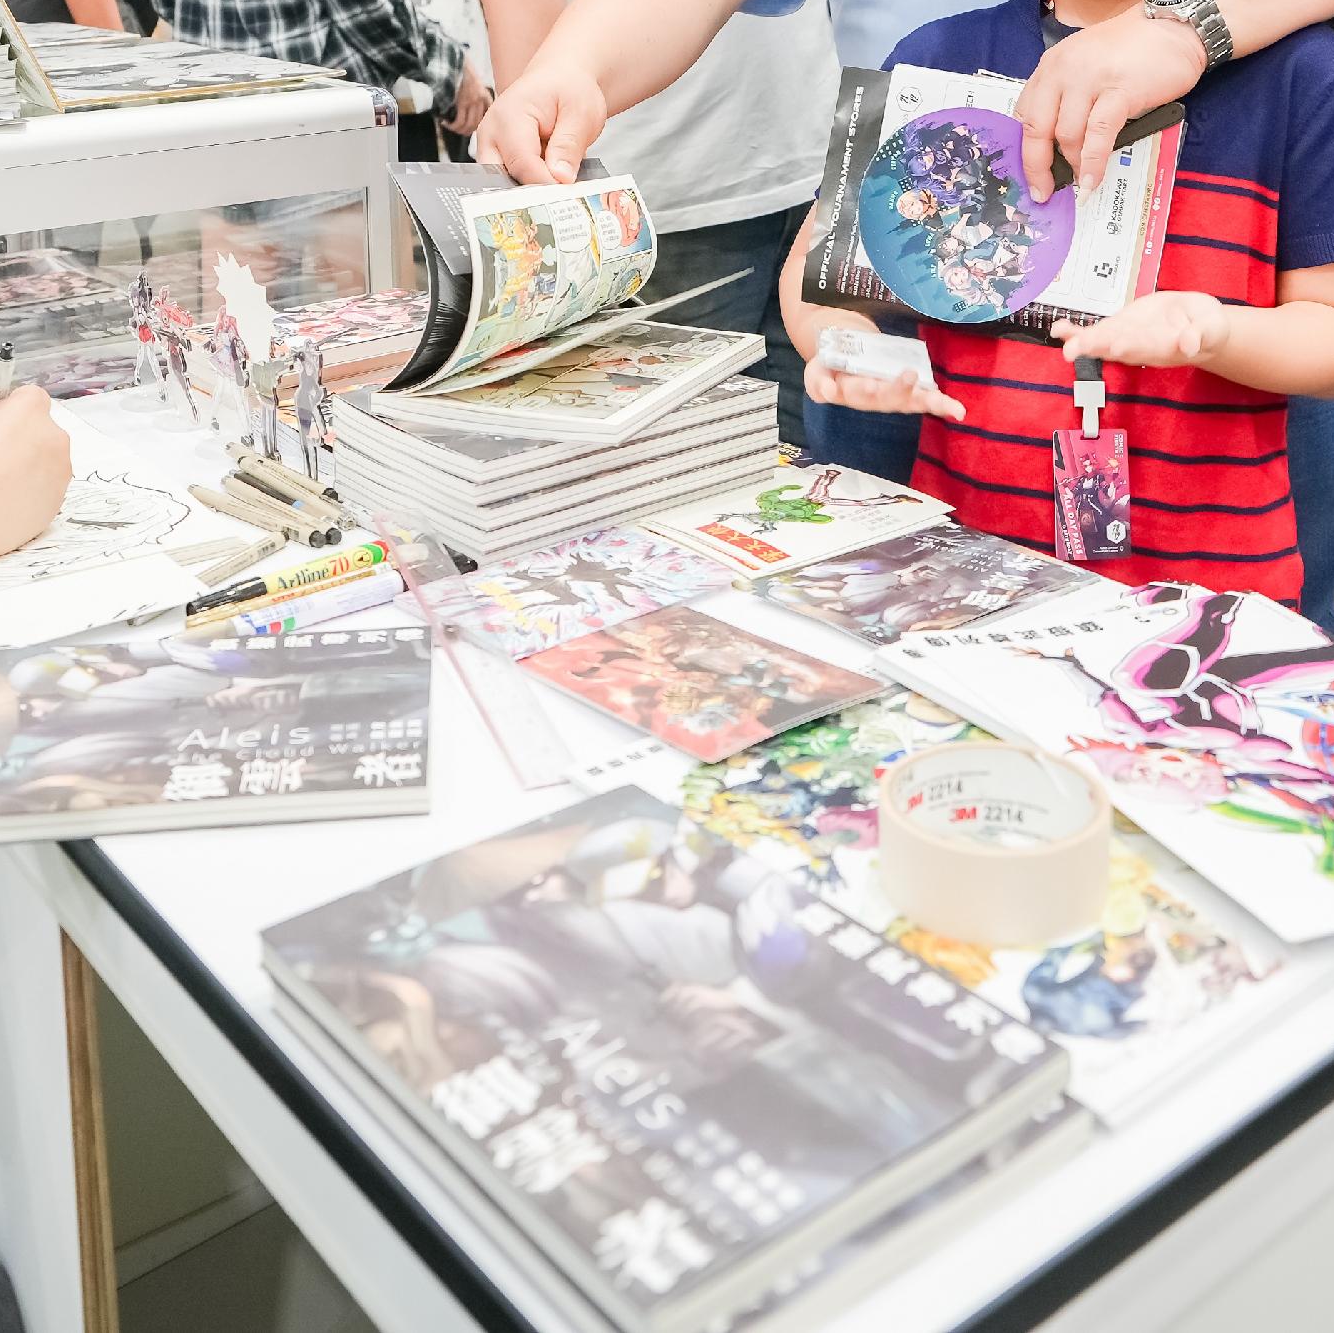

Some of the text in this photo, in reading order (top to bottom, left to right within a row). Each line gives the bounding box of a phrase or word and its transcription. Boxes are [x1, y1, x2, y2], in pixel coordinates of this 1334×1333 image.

[818, 85, 865, 290] OFFICIAL TOURNAMENT STORES
[1067, 512, 1078, 530] DAY
[1072, 530, 1083, 555] PASS
[277, 567, 330, 591] Artline
[330, 553, 349, 577] 70
[177, 722, 312, 752] Aleis
[329, 740, 422, 755] Walker
[950, 806, 1025, 824] 3M 2214
[540, 1018, 687, 1130] Aleis
